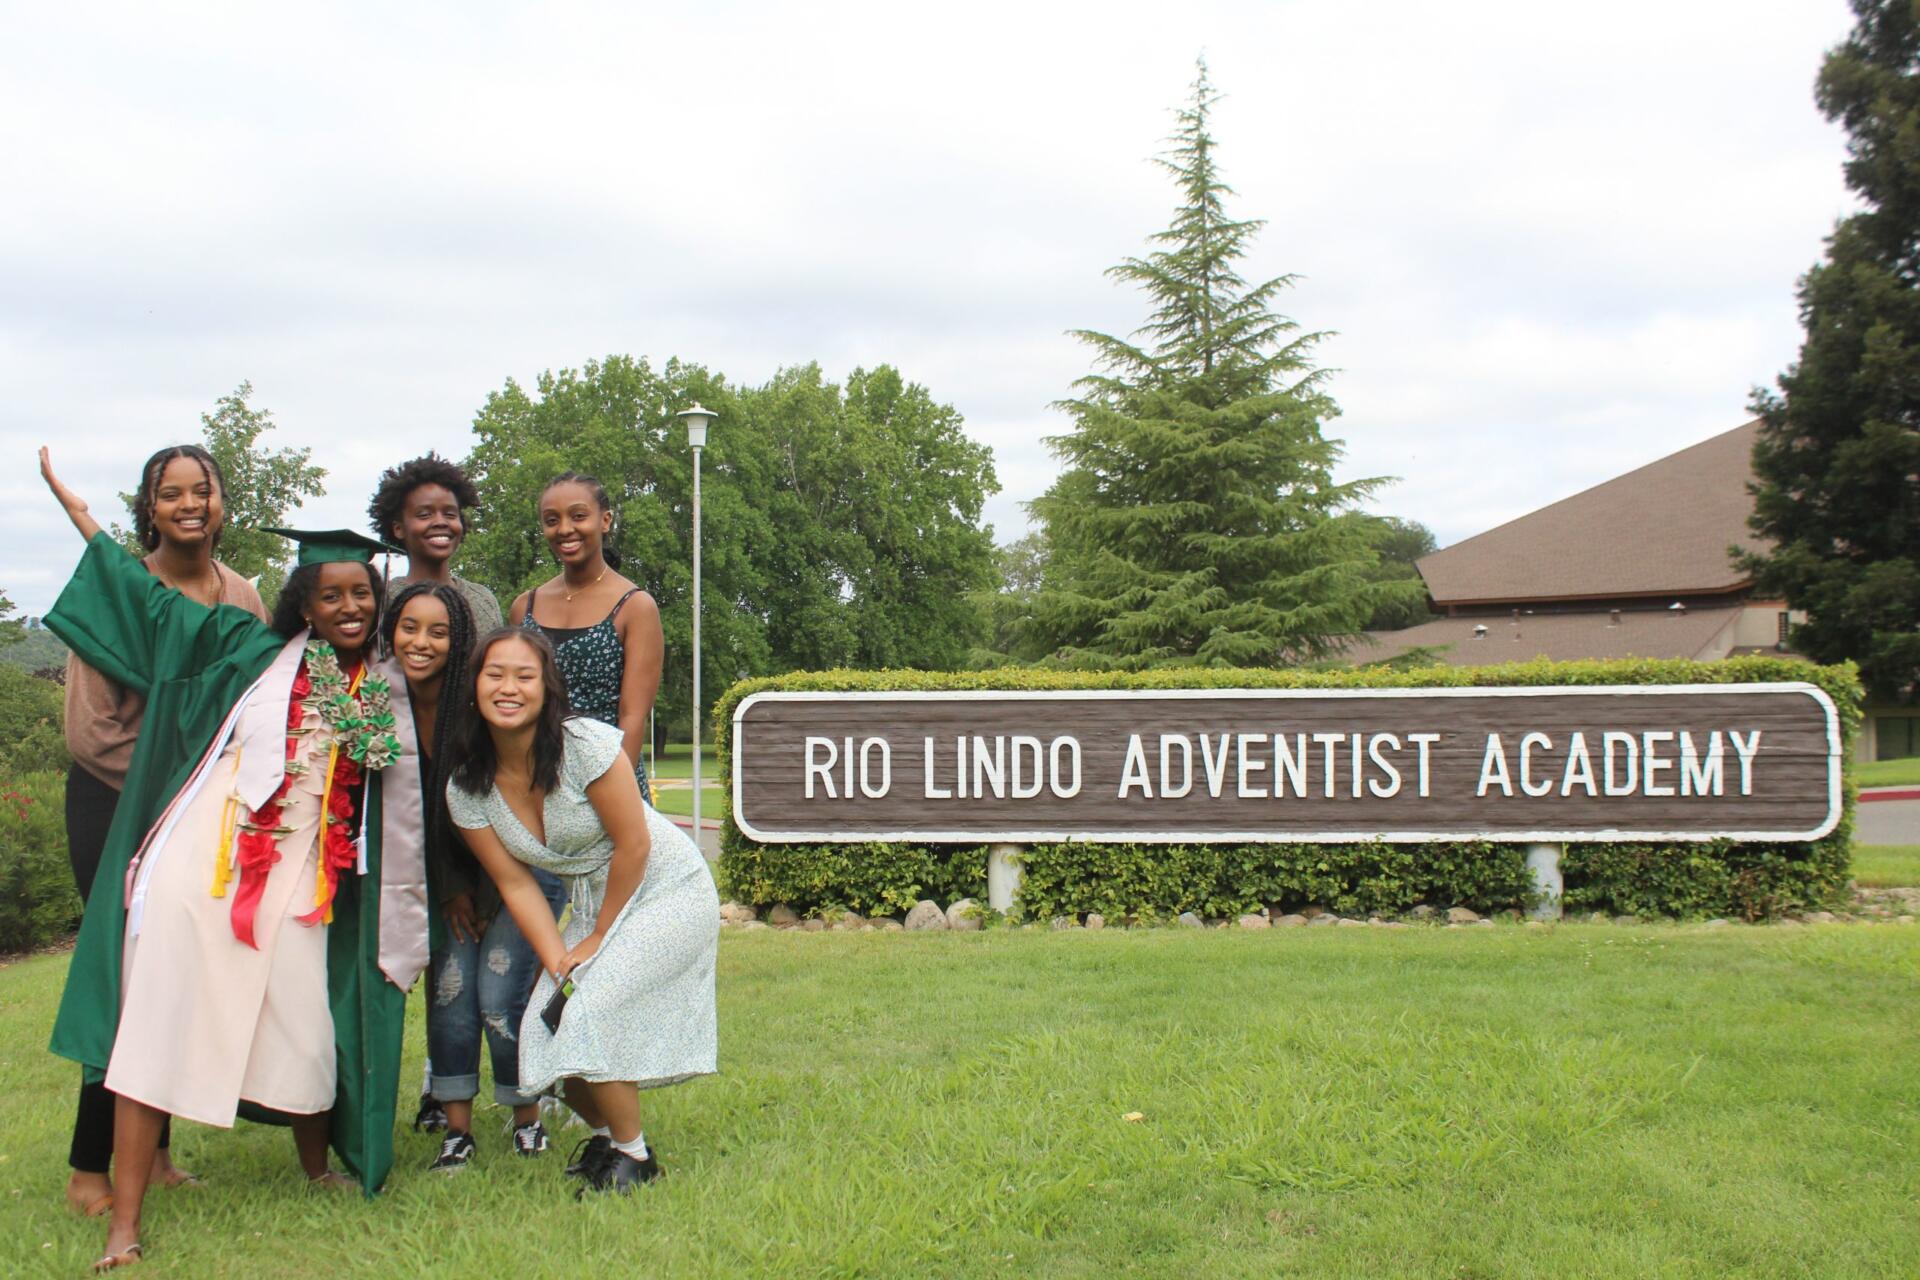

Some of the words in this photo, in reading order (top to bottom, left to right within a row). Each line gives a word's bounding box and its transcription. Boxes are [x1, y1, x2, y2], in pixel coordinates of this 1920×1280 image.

[804, 736, 892, 799] RIO
[924, 735, 1082, 799] LINDO
[1117, 732, 1441, 799] ADVENTIST
[1476, 729, 1762, 797] ACADEMY
